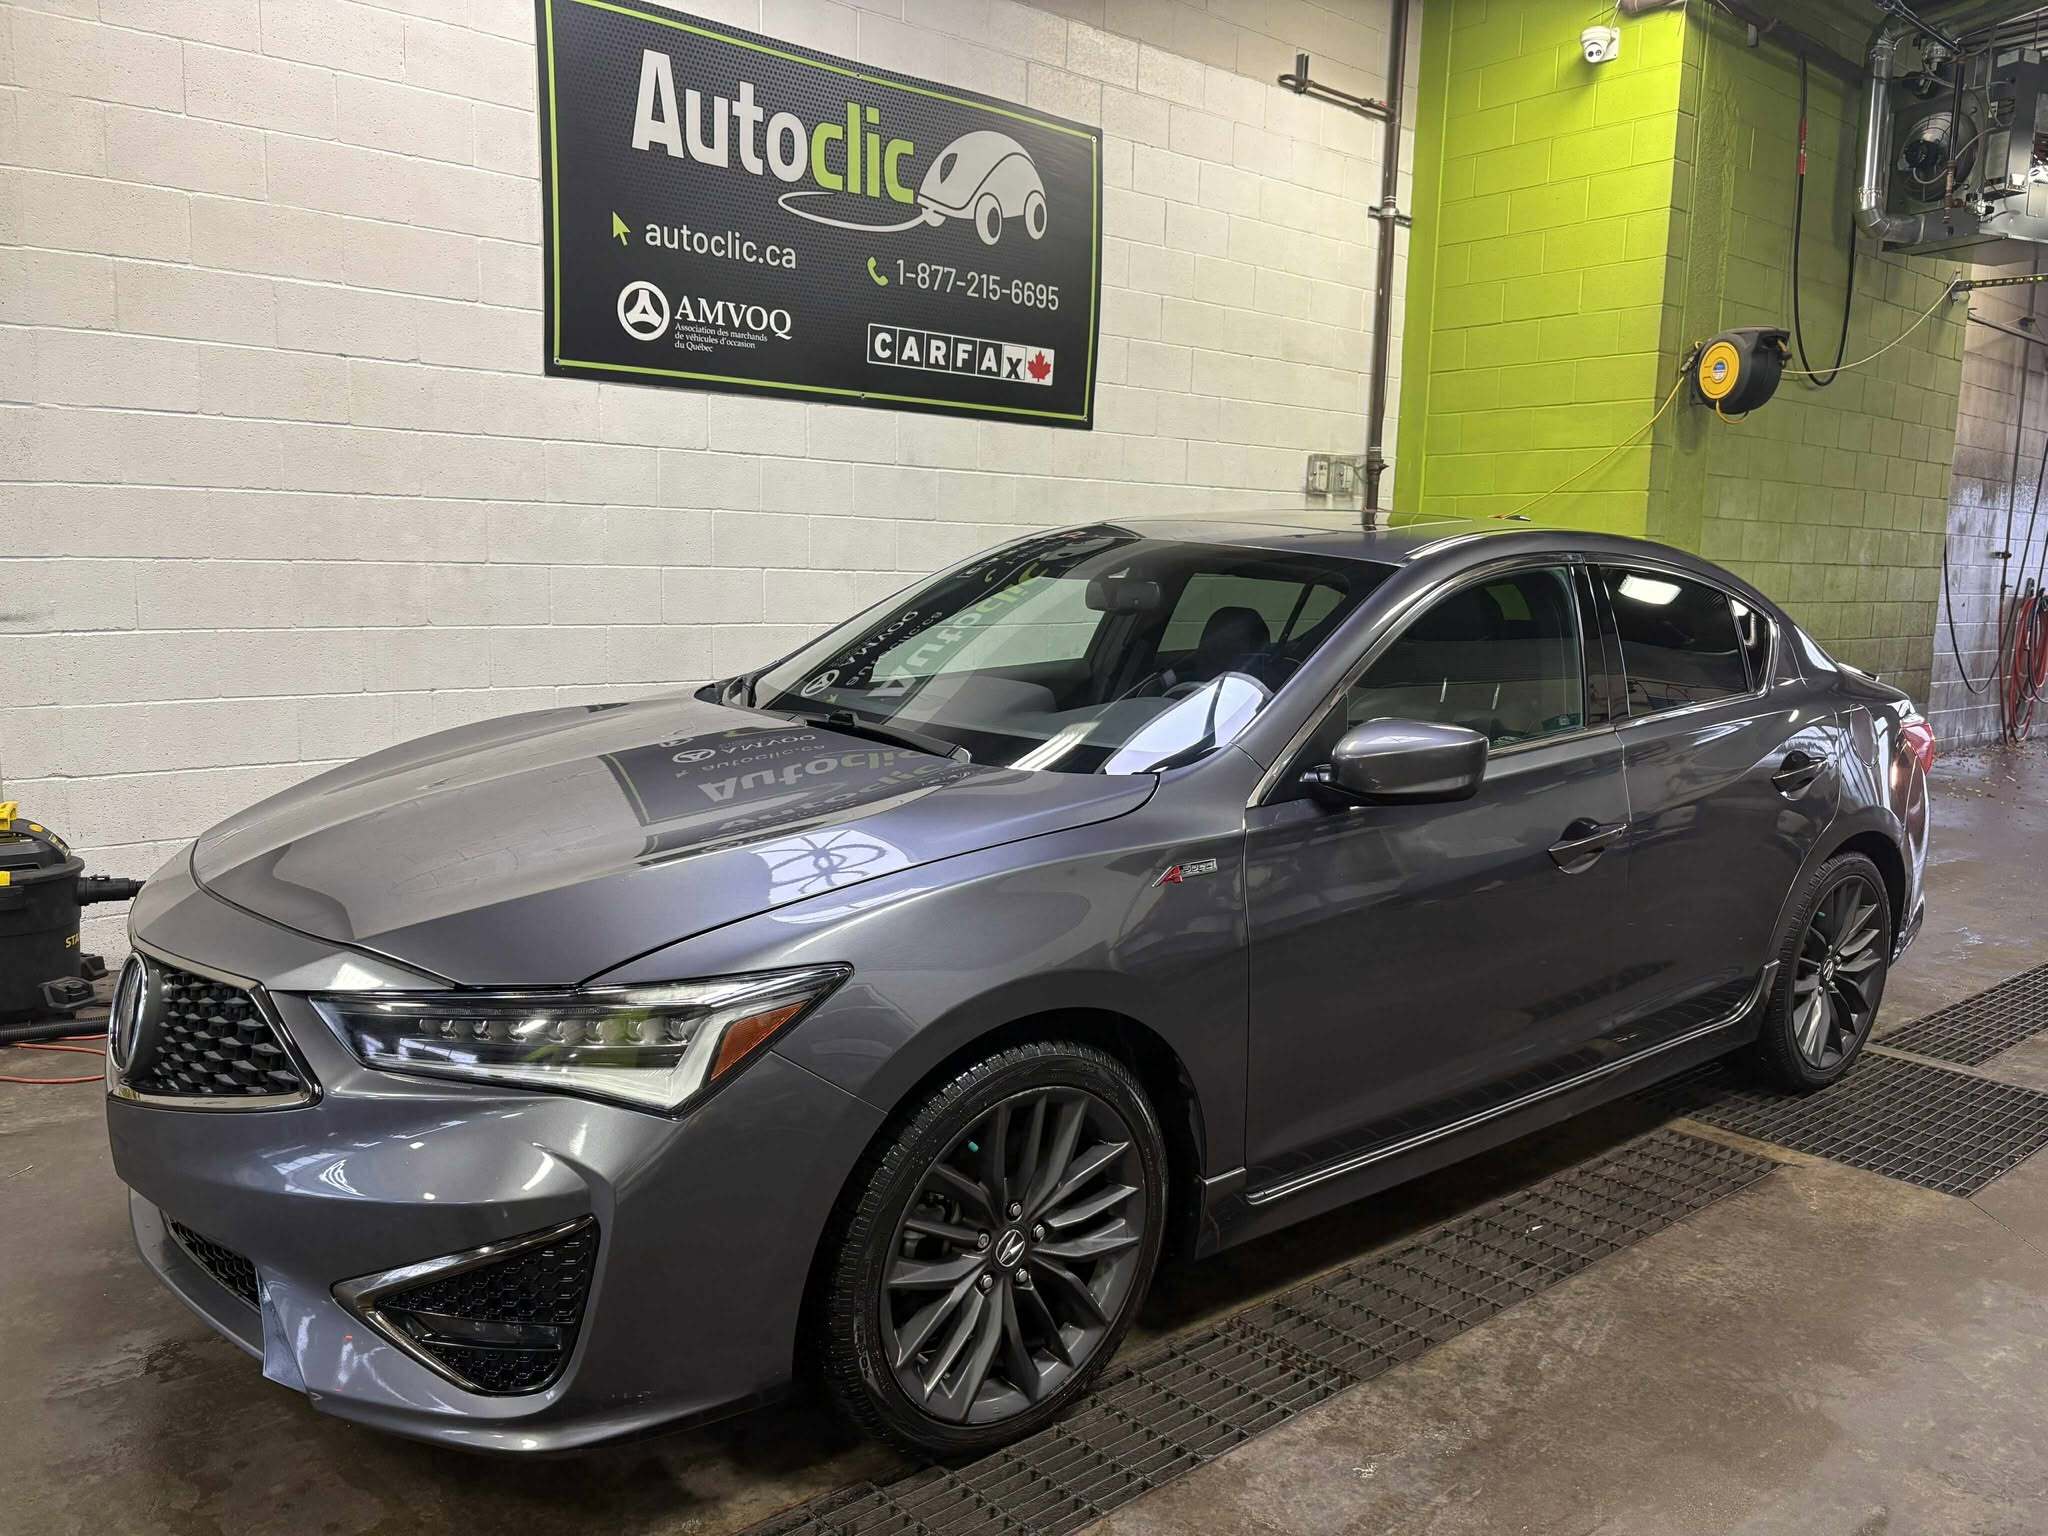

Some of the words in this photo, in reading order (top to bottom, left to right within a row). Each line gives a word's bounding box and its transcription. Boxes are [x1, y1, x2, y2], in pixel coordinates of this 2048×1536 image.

[631, 48, 915, 205] Autoclic
[644, 222, 798, 270] autoclic.ca
[896, 258, 1060, 311] 1-877-215-6695
[674, 295, 792, 340] AMVOQ
[674, 322, 716, 335] Association
[717, 327, 730, 336] des
[730, 331, 768, 342] marchands
[674, 331, 685, 341] de
[685, 333, 719, 345] véhicules
[674, 339, 685, 349] du
[686, 341, 713, 352] Québec
[874, 332, 1022, 380] CARFAX
